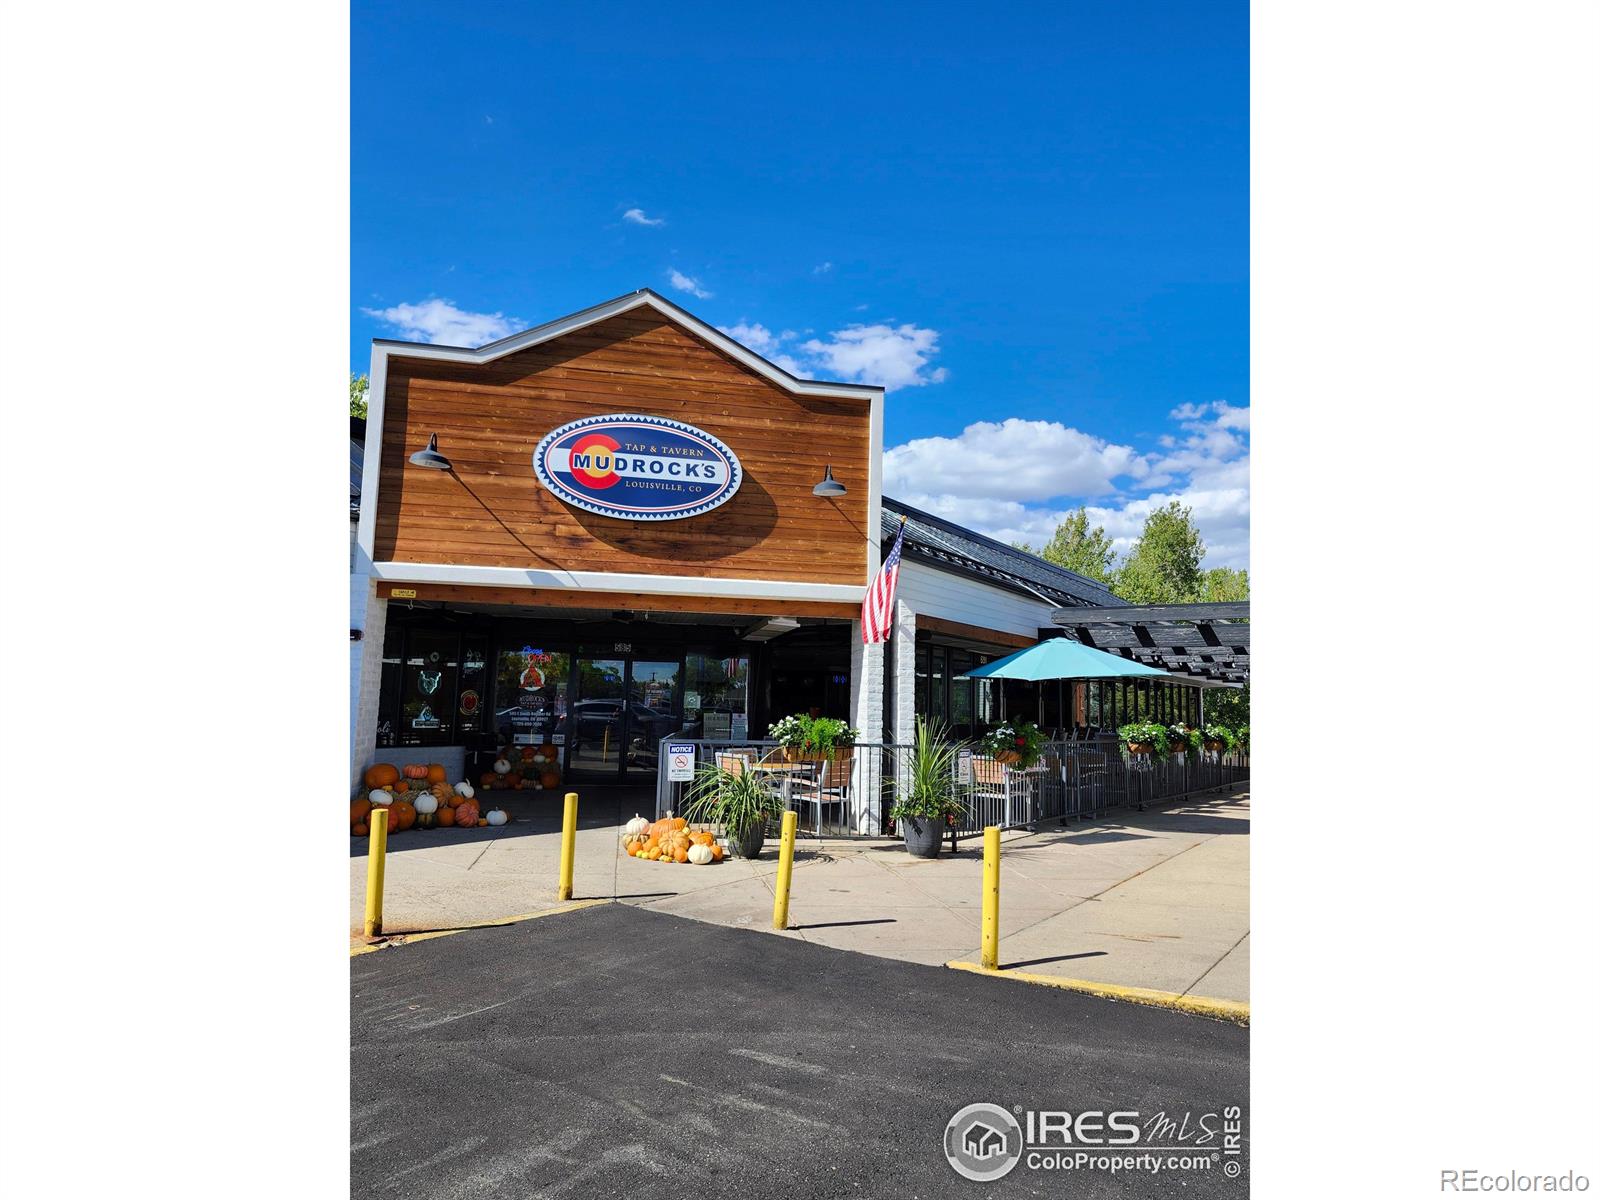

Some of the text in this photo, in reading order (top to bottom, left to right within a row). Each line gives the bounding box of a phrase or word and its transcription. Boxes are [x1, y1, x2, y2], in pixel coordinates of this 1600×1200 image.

[625, 443, 704, 457] TAP & TAVERN
[573, 453, 716, 479] MUDROCK'S
[625, 481, 702, 493] LOUISVILLE, CO
